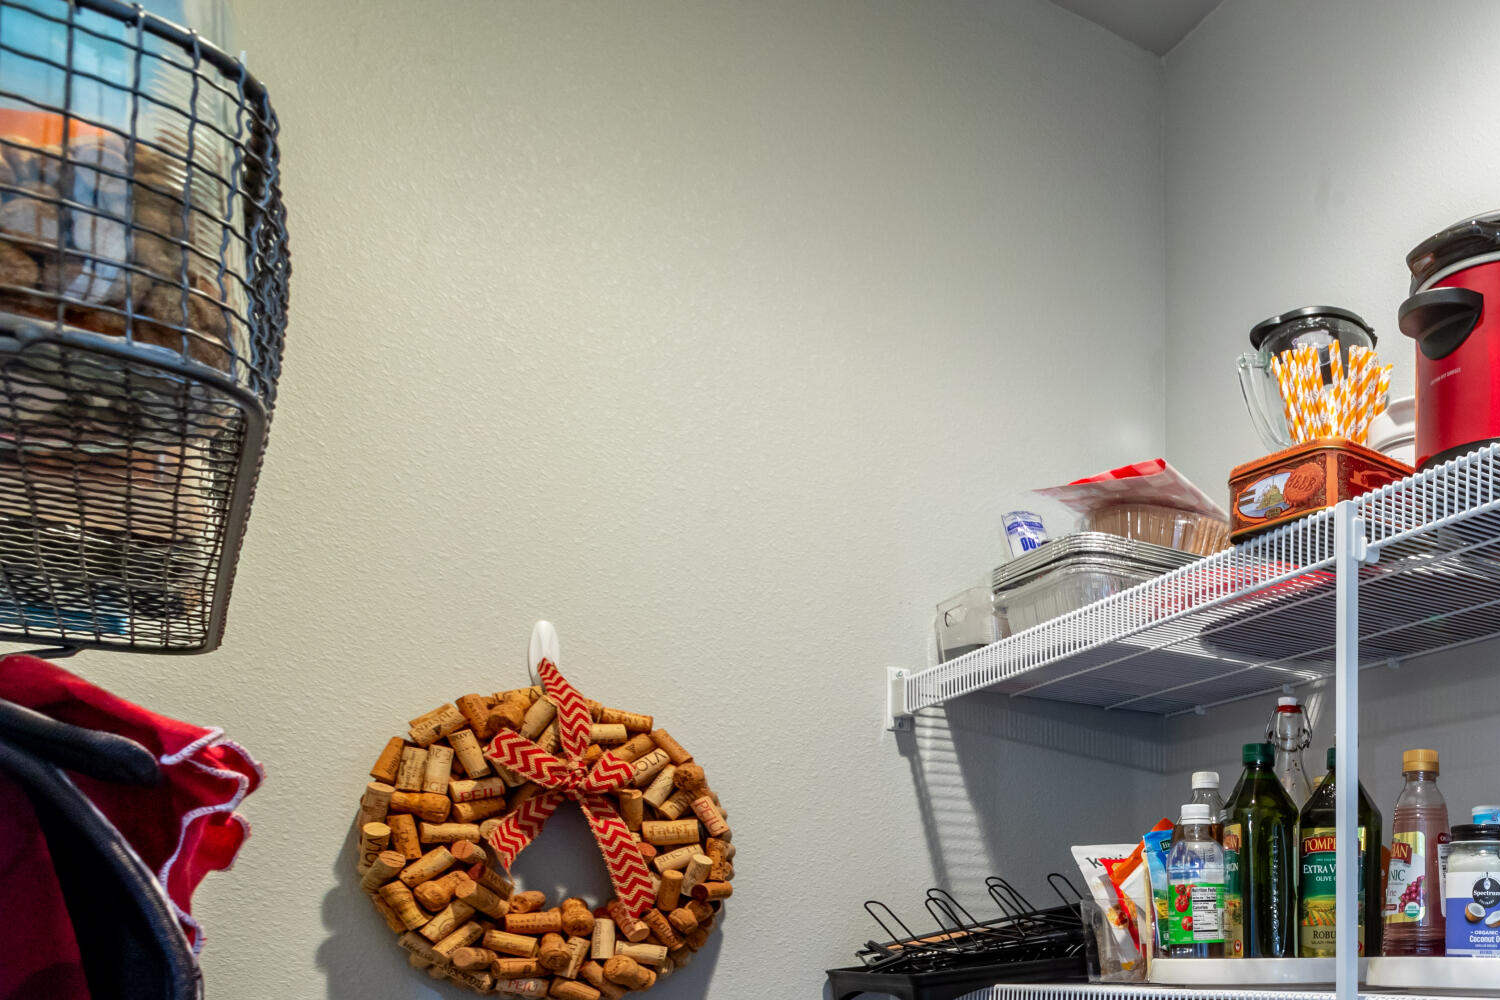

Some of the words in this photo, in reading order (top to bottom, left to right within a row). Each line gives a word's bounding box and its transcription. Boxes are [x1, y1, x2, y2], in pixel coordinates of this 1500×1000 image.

[1303, 864, 1326, 875] EXTRA
[1316, 874, 1332, 883] OLIVE
[1473, 889, 1500, 898] Spectrum
[1469, 935, 1494, 943] Coconut
